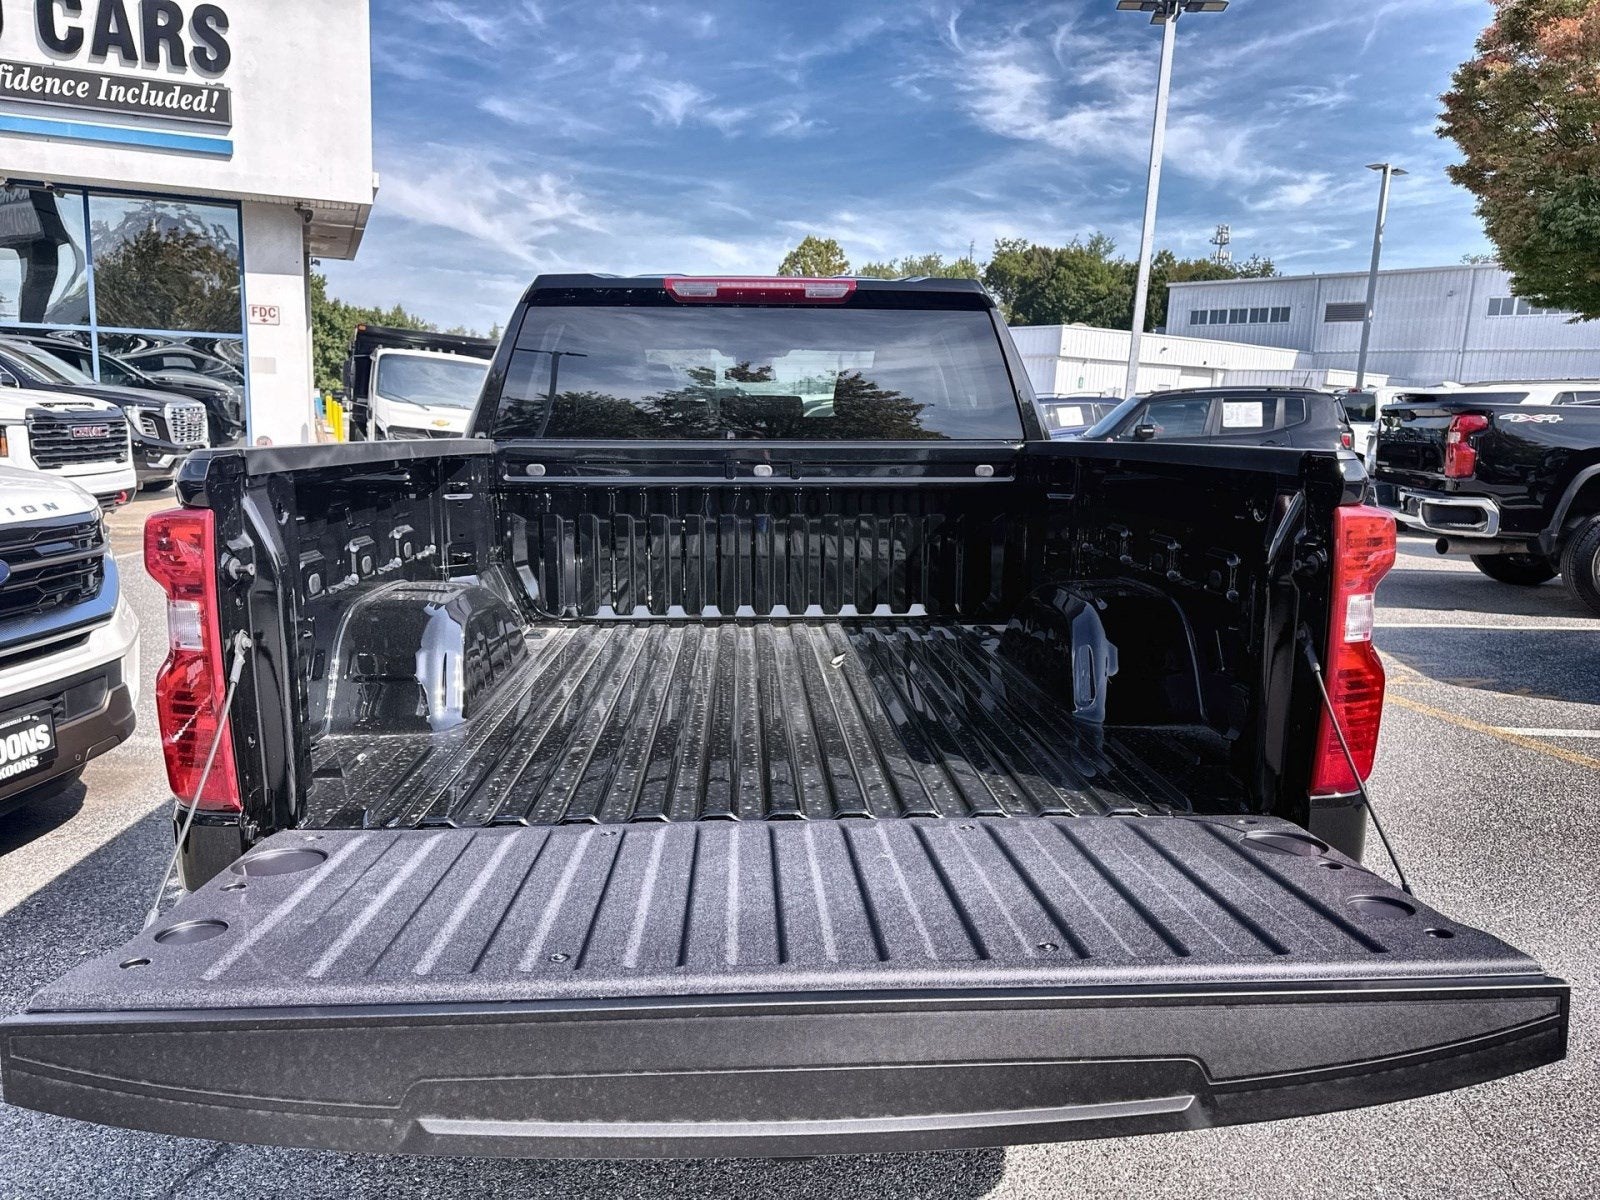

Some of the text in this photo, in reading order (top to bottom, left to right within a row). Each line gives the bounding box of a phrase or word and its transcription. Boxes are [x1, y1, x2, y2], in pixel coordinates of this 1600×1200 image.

[35, 0, 231, 78] CARS
[97, 77, 219, 113] Included!
[251, 306, 277, 318] FDC
